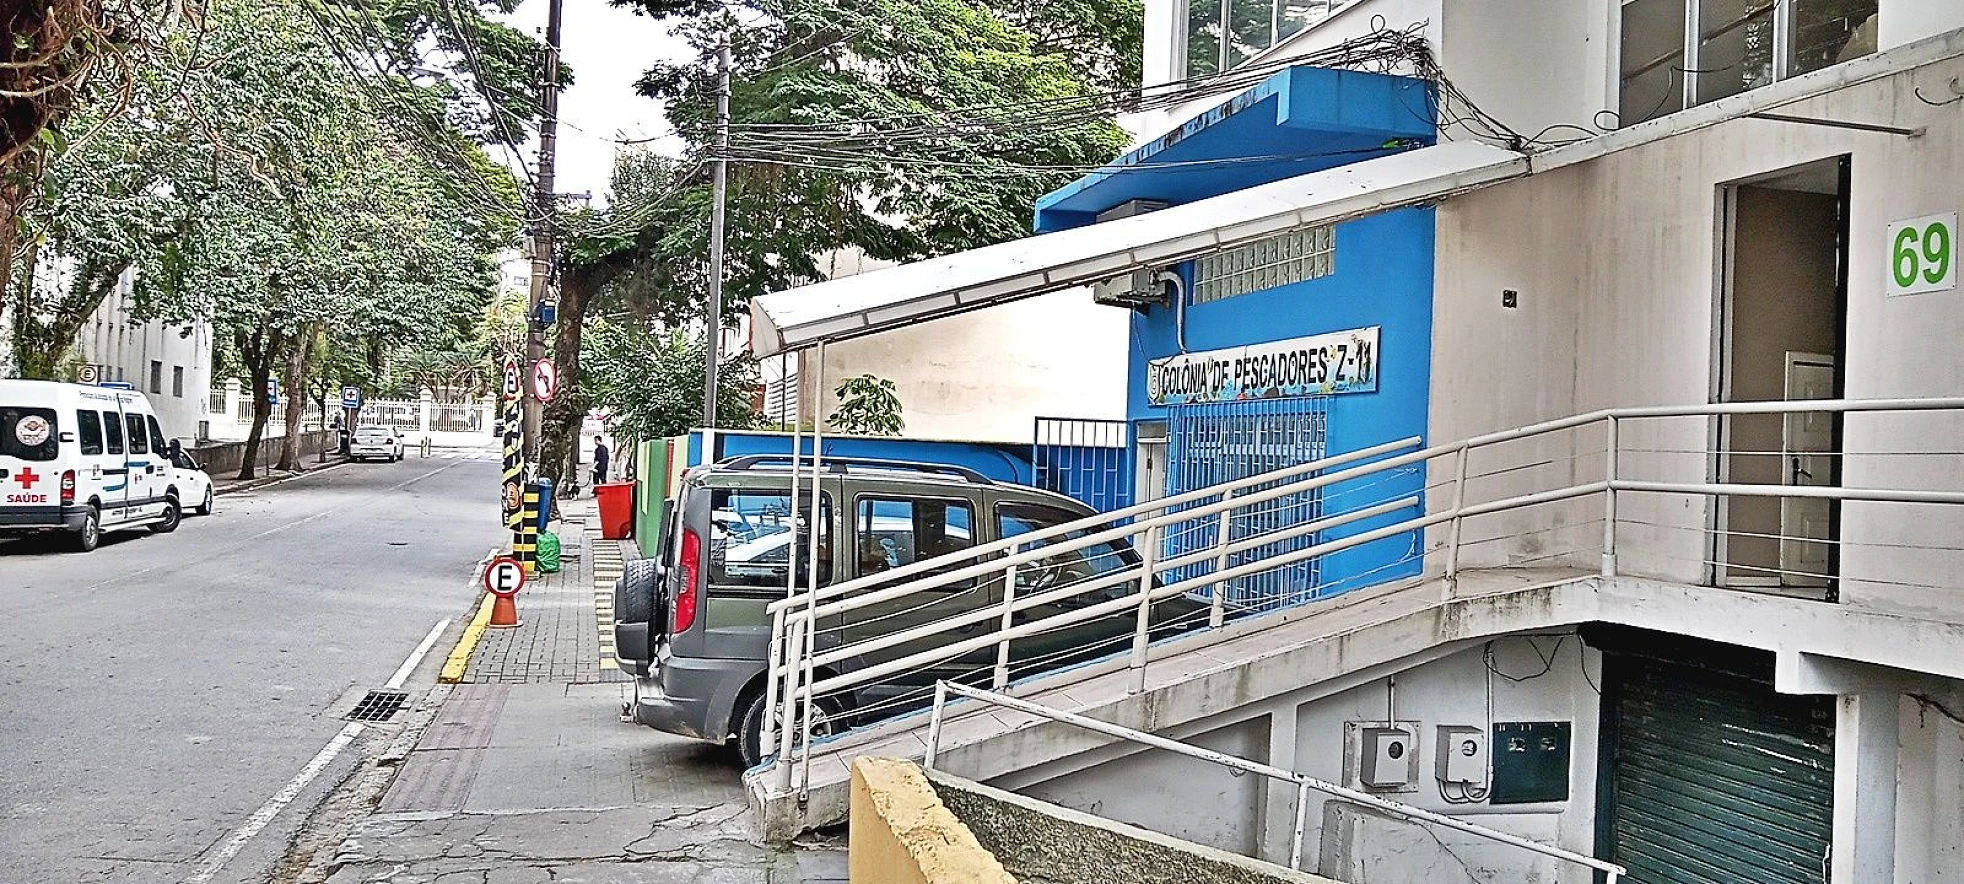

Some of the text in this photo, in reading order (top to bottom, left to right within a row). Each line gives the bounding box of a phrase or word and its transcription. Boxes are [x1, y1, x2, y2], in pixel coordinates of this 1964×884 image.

[1893, 222, 1950, 288] 69
[1162, 339, 1371, 395] COLÔNIA DE PESCADORES Z-11
[507, 371, 514, 394] E
[6, 492, 47, 503] SAÚDE
[497, 565, 513, 591] E
